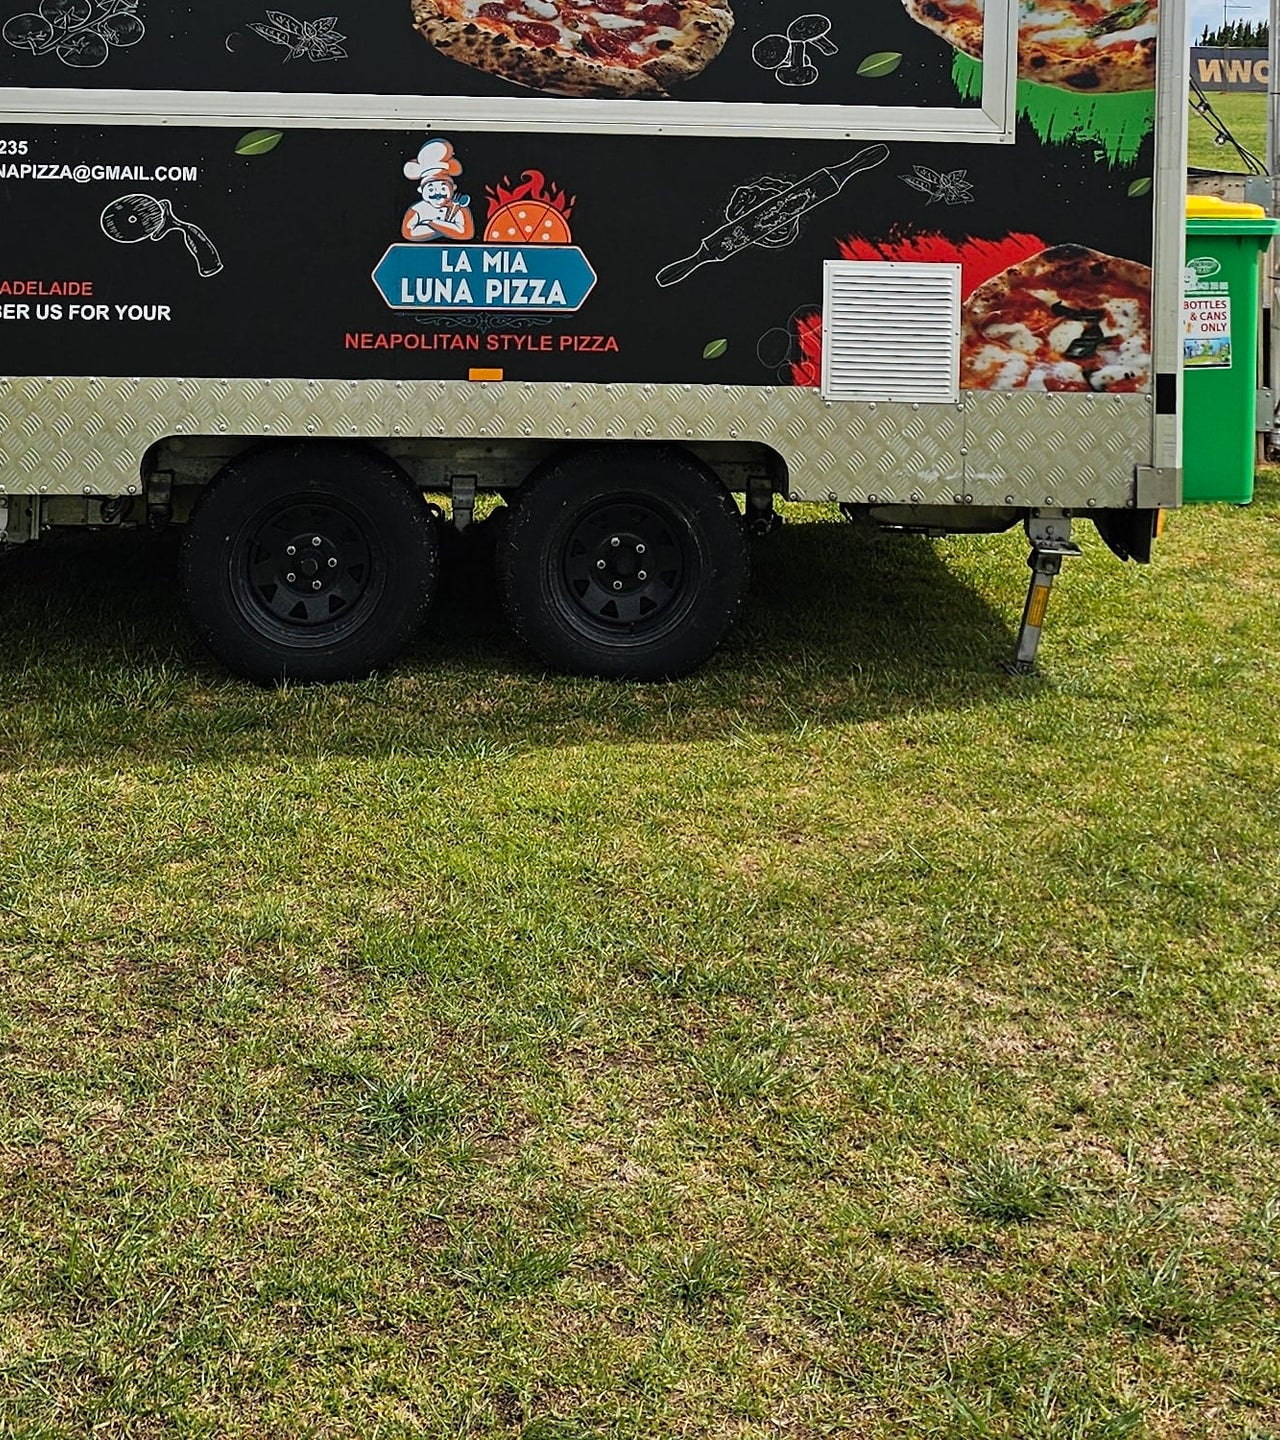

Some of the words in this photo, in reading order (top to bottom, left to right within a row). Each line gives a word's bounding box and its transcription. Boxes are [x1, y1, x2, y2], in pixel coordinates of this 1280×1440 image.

[441, 250, 473, 273] LA
[482, 251, 528, 274] MIA
[0, 280, 93, 297] ADELAIDE
[400, 277, 474, 304] LUNA
[485, 279, 567, 305] PIZZA
[35, 304, 63, 321] US
[68, 304, 110, 321] FOR
[114, 305, 171, 321] YOUR
[1183, 300, 1227, 310] BOTTLES
[1199, 311, 1227, 321] CANS
[1201, 322, 1227, 332] ONLY
[344, 332, 480, 351] NEAPOLITAN
[486, 334, 552, 352] STYLE
[559, 334, 619, 352] PIZZA
